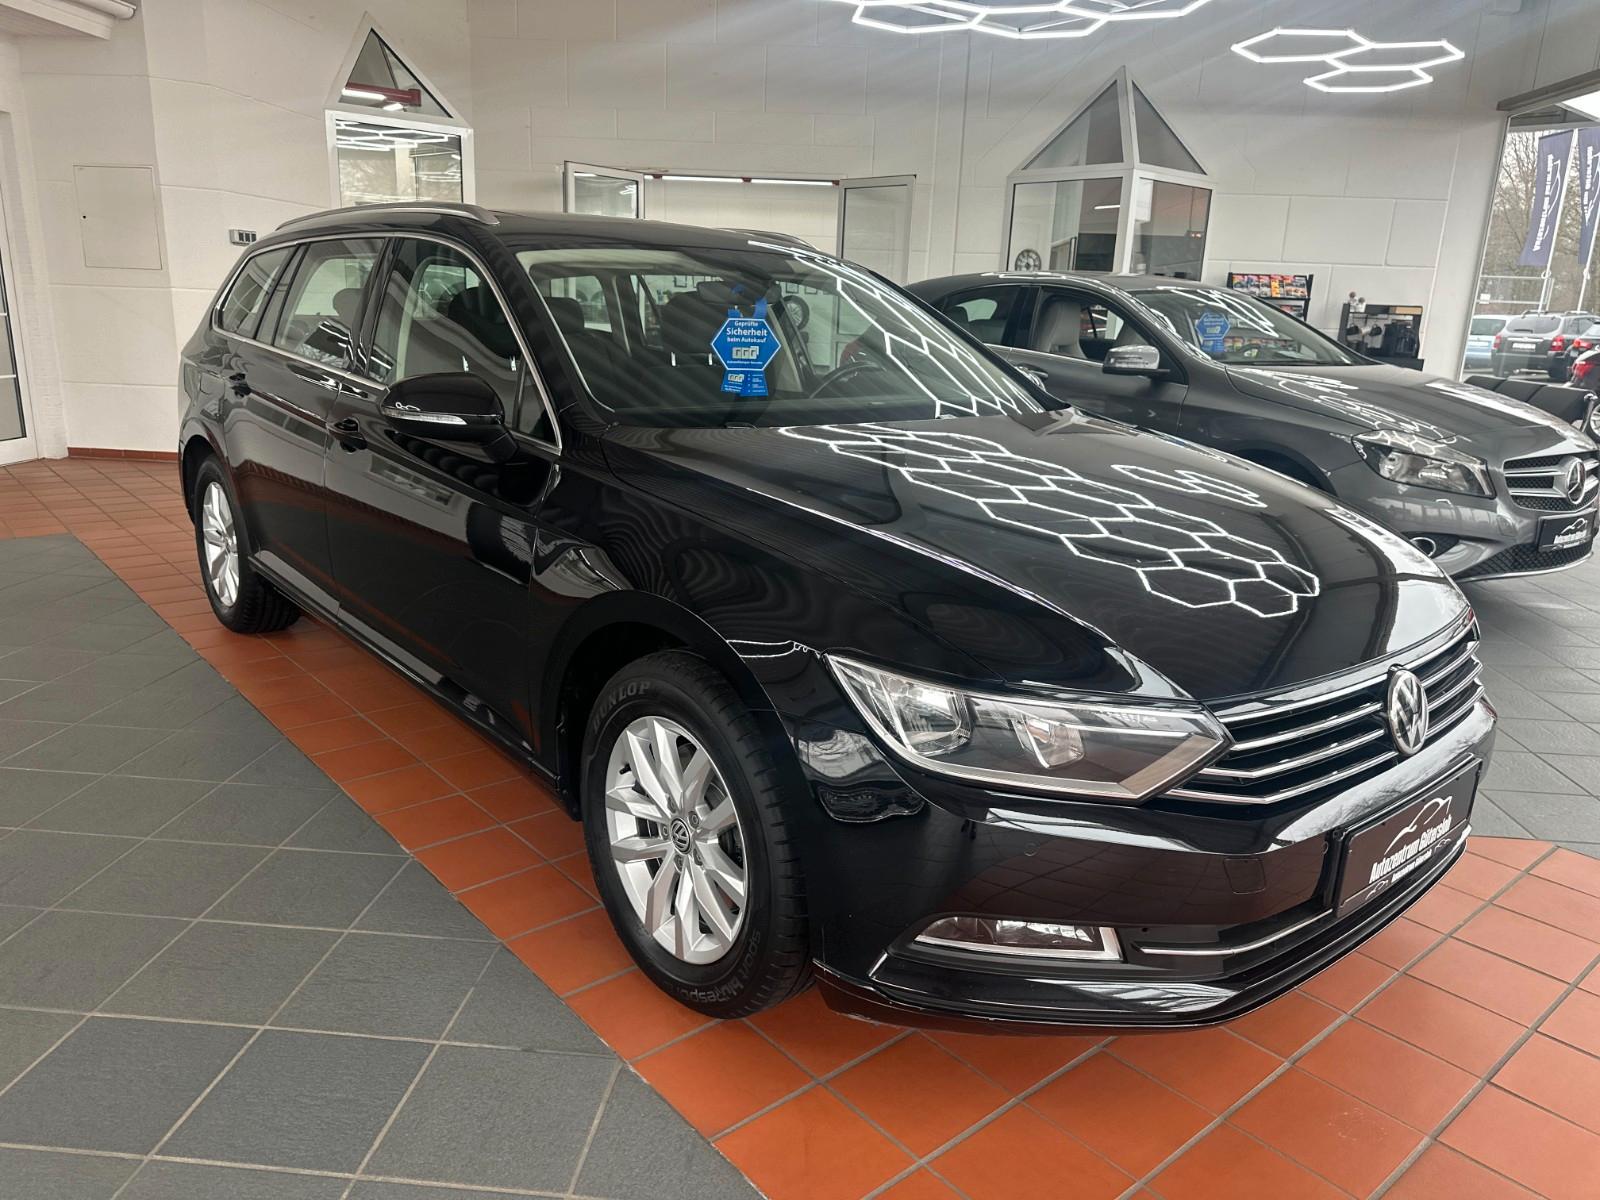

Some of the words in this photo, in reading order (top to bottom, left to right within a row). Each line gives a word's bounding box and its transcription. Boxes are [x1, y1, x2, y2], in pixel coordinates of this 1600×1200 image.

[726, 328, 768, 337] Sicherheit
[592, 680, 651, 735] DUNLOP
[1369, 838, 1420, 884] Autozentrum
[1418, 814, 1451, 851] Gütersloh
